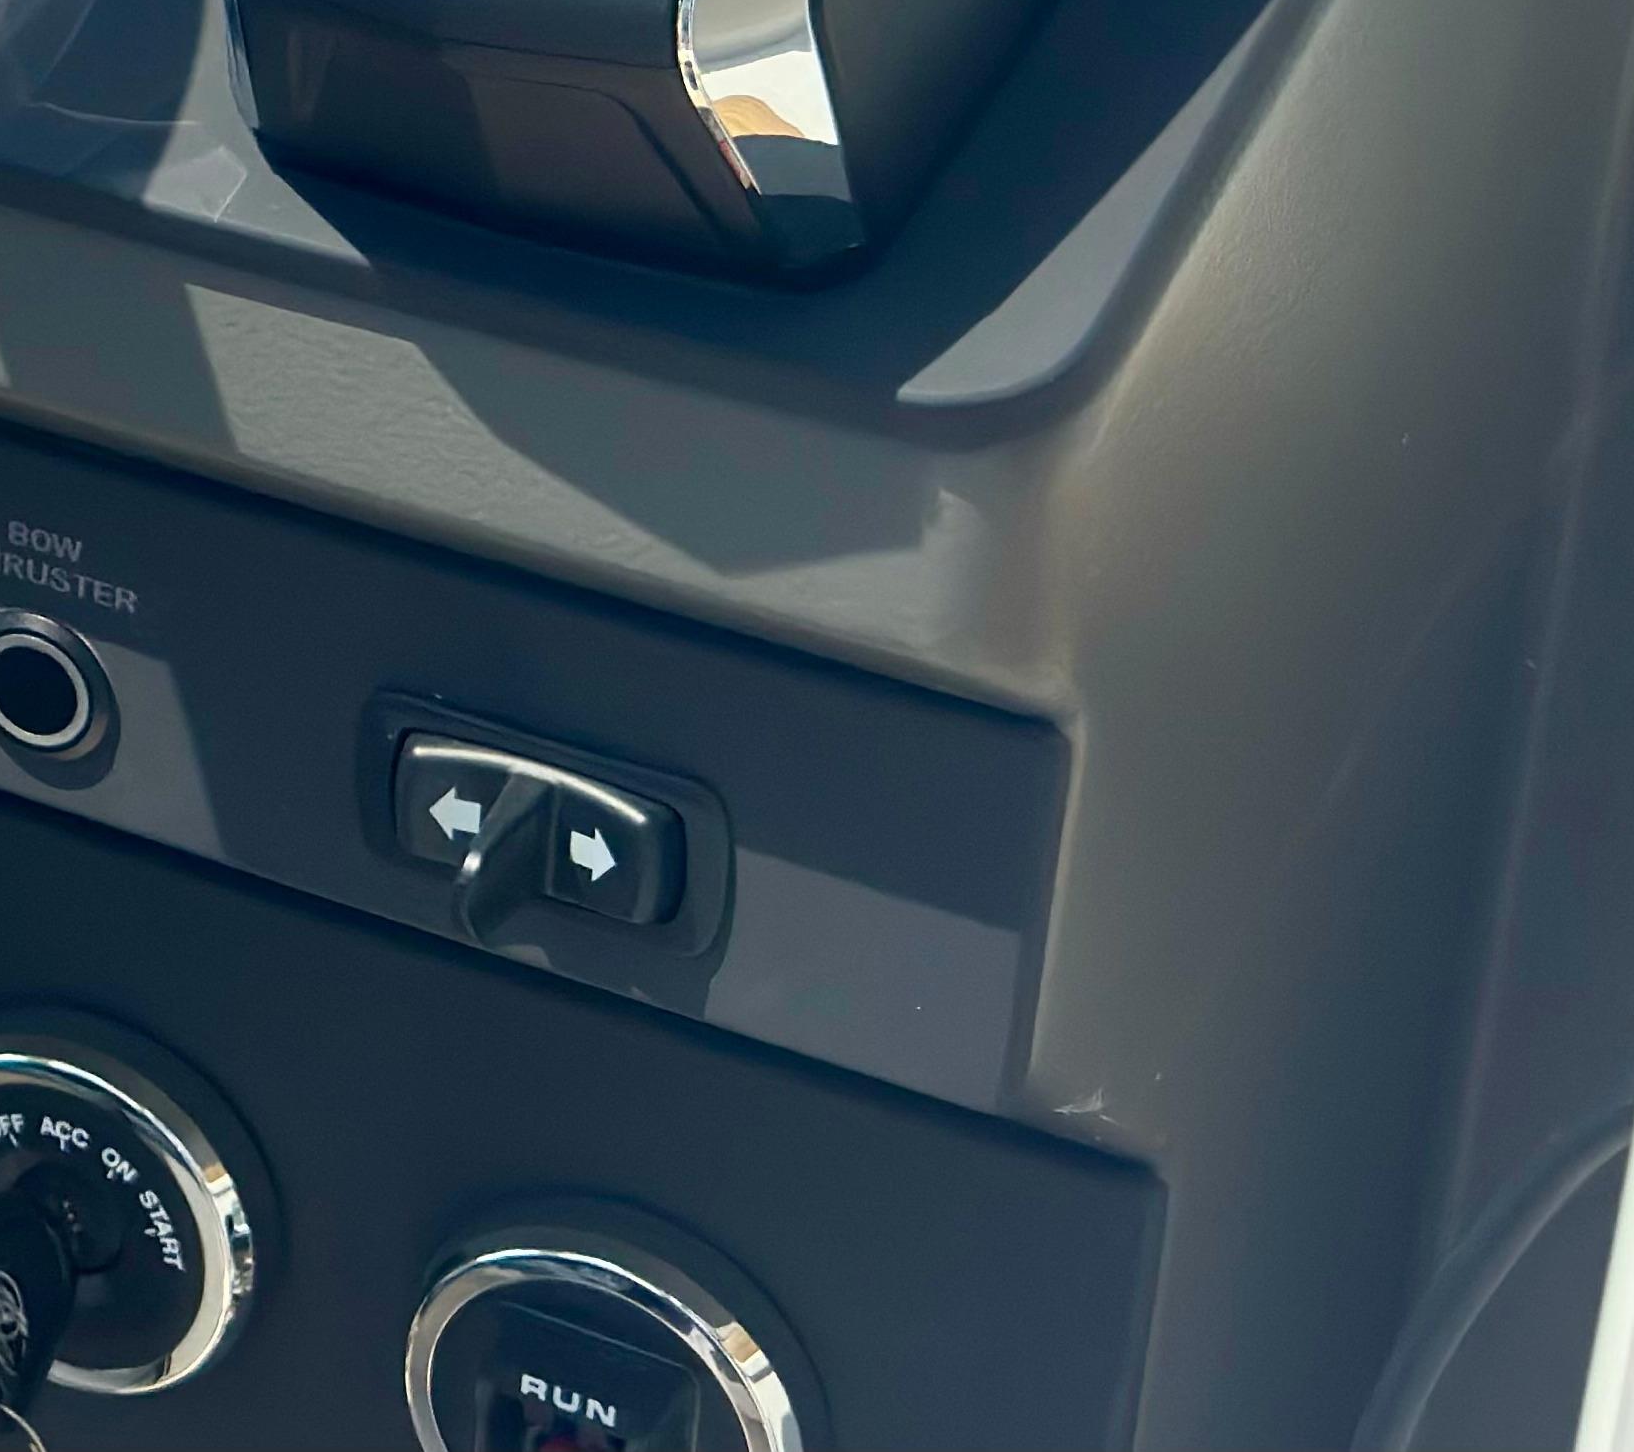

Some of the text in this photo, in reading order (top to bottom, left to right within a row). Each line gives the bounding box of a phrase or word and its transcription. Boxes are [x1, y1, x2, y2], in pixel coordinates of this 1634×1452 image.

[8, 520, 82, 562] BOW
[40, 1115, 90, 1147] ACC
[101, 1147, 137, 1183] ON
[139, 1190, 185, 1273] START
[520, 1374, 616, 1427] RUN
